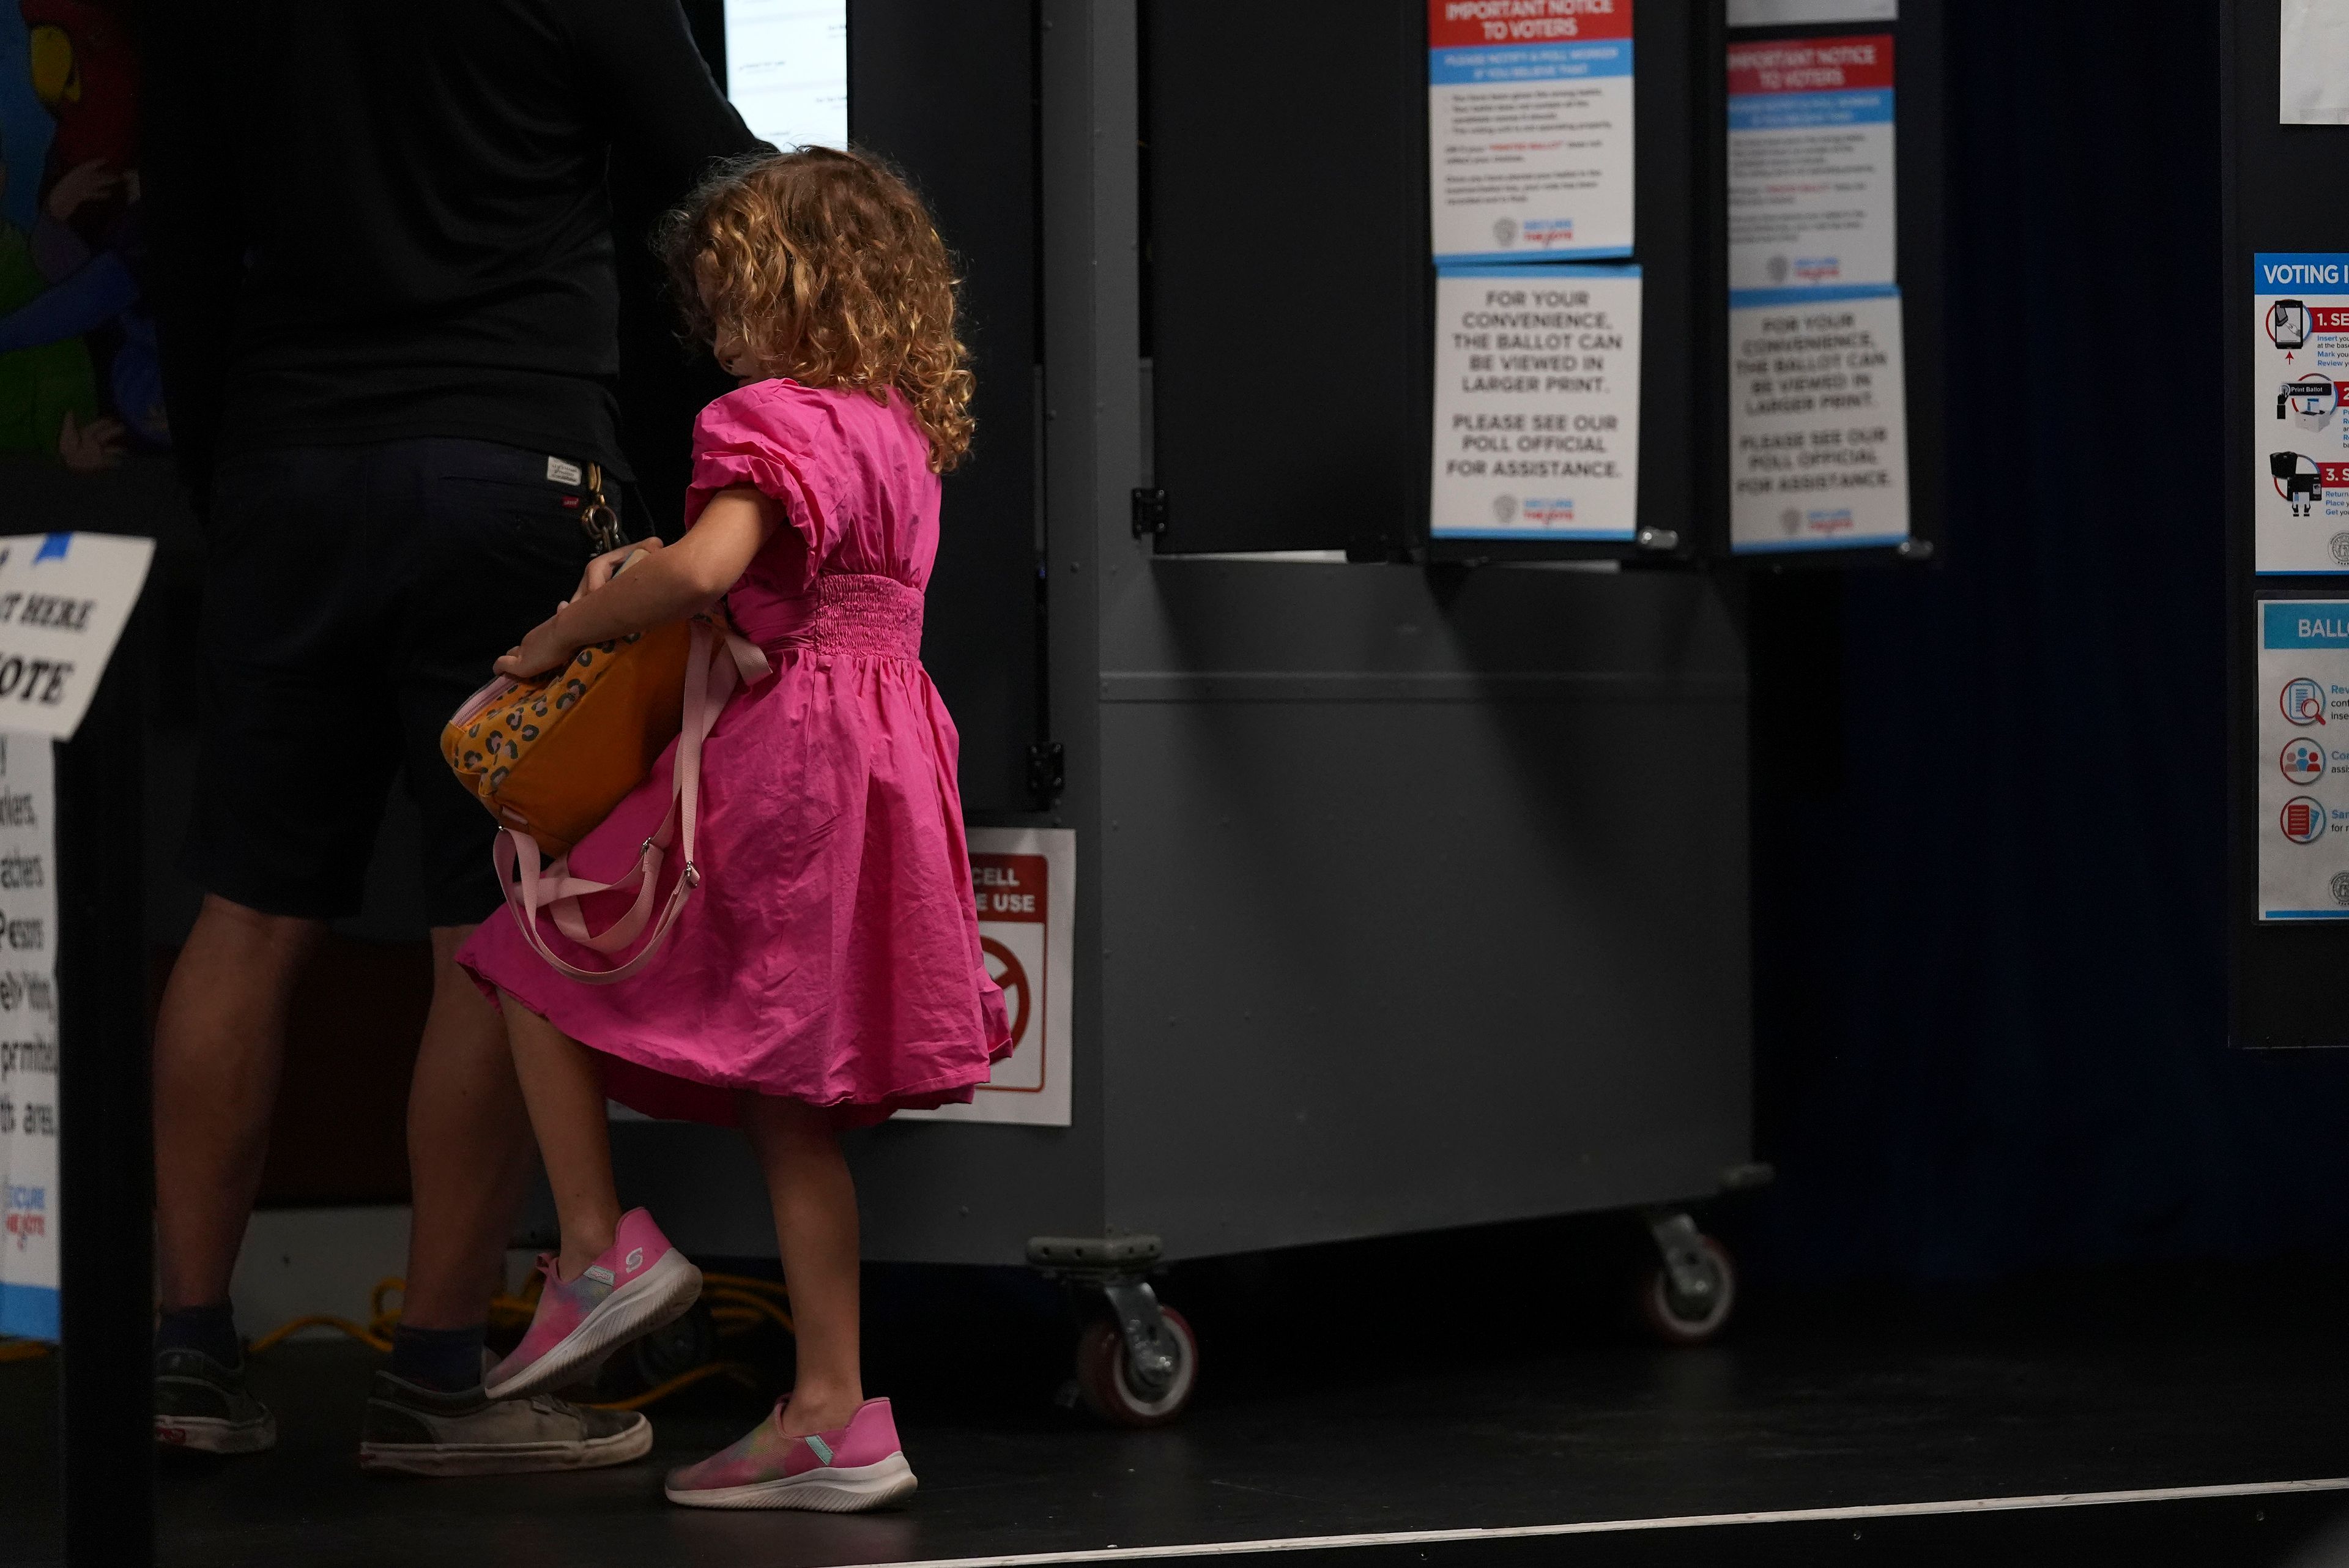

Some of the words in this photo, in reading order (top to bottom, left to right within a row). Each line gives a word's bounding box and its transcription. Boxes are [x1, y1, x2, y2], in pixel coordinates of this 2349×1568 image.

[1445, 0, 1545, 20] IMPORTANT
[1548, 0, 1614, 15] NOTICE
[1482, 21, 1508, 39] TO
[1508, 17, 1578, 38] VOTERS
[2263, 264, 2339, 284] VOTING
[1486, 290, 1526, 307] FOR
[1532, 290, 1589, 307] YOUR
[1762, 316, 1798, 333] FOR
[1805, 313, 1855, 331] YOUR
[2317, 313, 2328, 326] 1.
[2330, 313, 2349, 326] SE
[1452, 332, 1488, 350] THE
[1496, 332, 1573, 350] BALLOT
[1578, 333, 1623, 350] CAN
[1469, 354, 1493, 371] BE
[1501, 354, 1578, 371] VIEWED
[1583, 354, 1603, 371] IN
[1462, 376, 1540, 393] LARGER
[1545, 376, 1611, 393] PRINT.
[1452, 414, 1526, 431] PLEASE
[1532, 414, 1567, 431] SEE
[1573, 414, 1618, 431] OUR
[1462, 434, 1512, 452] POLL
[1516, 434, 1606, 453] OFFICIAL
[1446, 459, 1486, 477] FOR
[1492, 460, 1623, 478] ASSISTANCE.
[2326, 468, 2339, 481] 3.
[2298, 619, 2349, 637] BALL
[0, 653, 75, 706] OTE
[2331, 823, 2343, 832] for
[973, 867, 1020, 887] CELL
[993, 893, 1036, 913] USE
